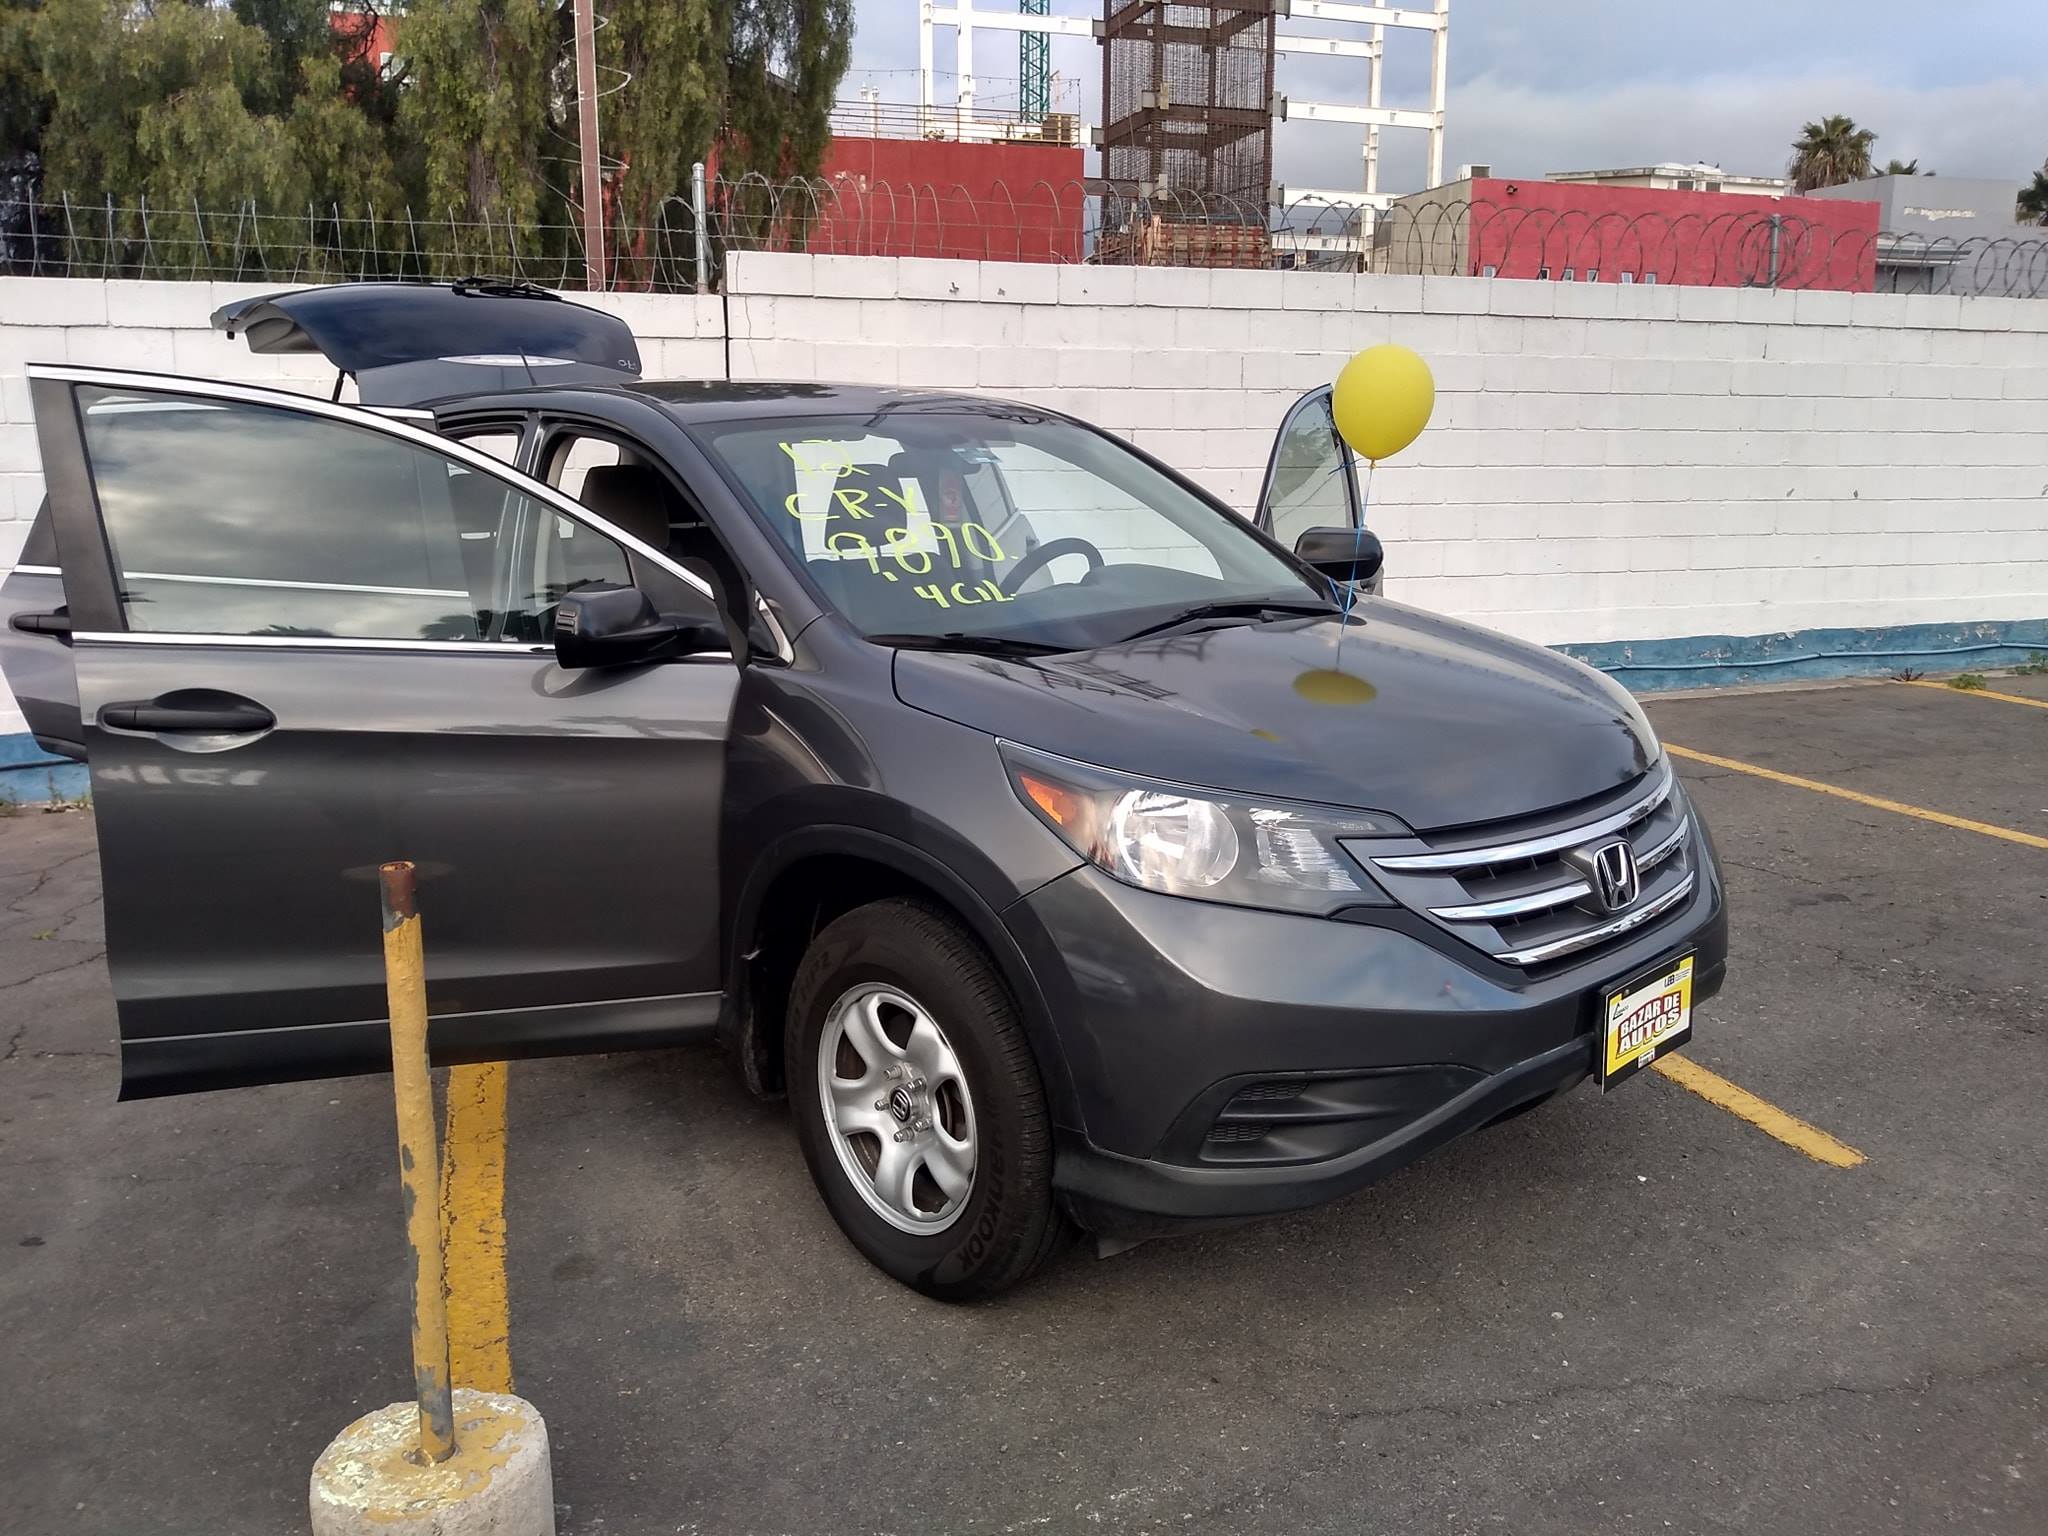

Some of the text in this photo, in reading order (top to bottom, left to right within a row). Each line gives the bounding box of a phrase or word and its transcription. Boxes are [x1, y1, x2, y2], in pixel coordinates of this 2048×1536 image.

[778, 438, 871, 480] 12
[785, 486, 916, 520] CR-V
[1618, 1007, 1681, 1055] AUTOS
[1620, 999, 1661, 1035] BAZAR
[1663, 994, 1680, 1012] DE
